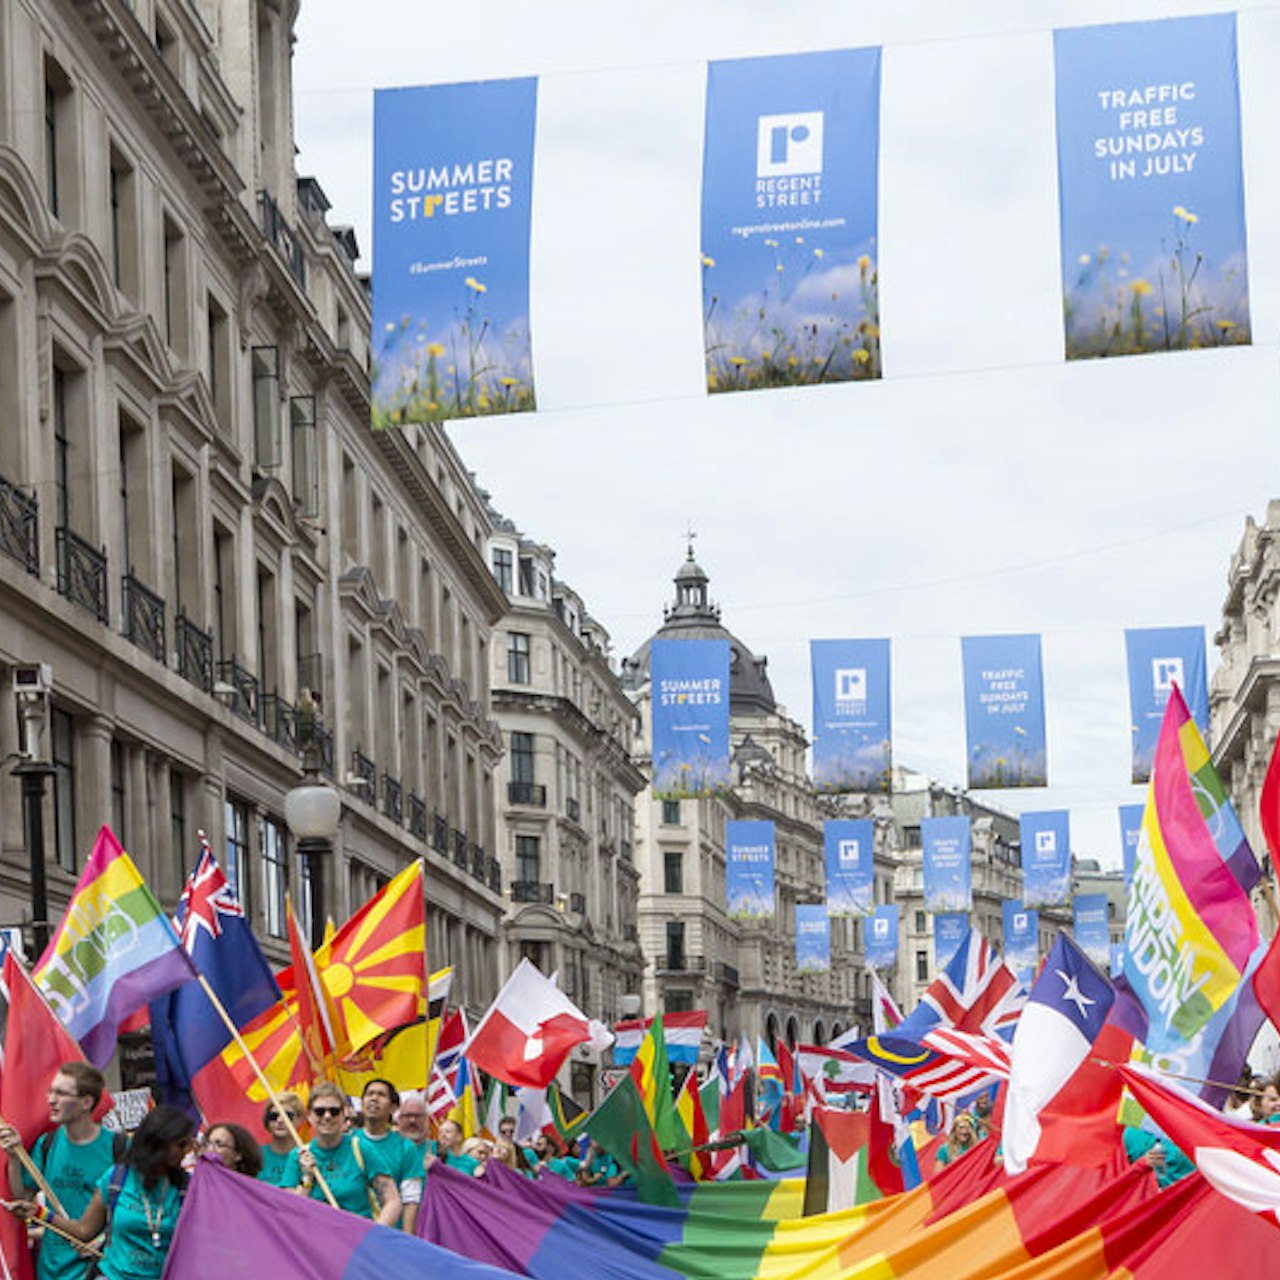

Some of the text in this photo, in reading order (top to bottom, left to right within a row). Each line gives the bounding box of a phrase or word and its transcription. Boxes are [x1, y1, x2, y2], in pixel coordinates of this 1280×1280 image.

[1097, 82, 1196, 111] TRAFFIC
[1119, 106, 1177, 131] FREE
[1094, 127, 1204, 158] SUNDAYS
[391, 158, 513, 195] SUMMER
[1110, 151, 1197, 181] IN JULY
[755, 175, 822, 193] REGENT
[756, 190, 822, 208] STREET
[660, 679, 721, 693] SUMMER
